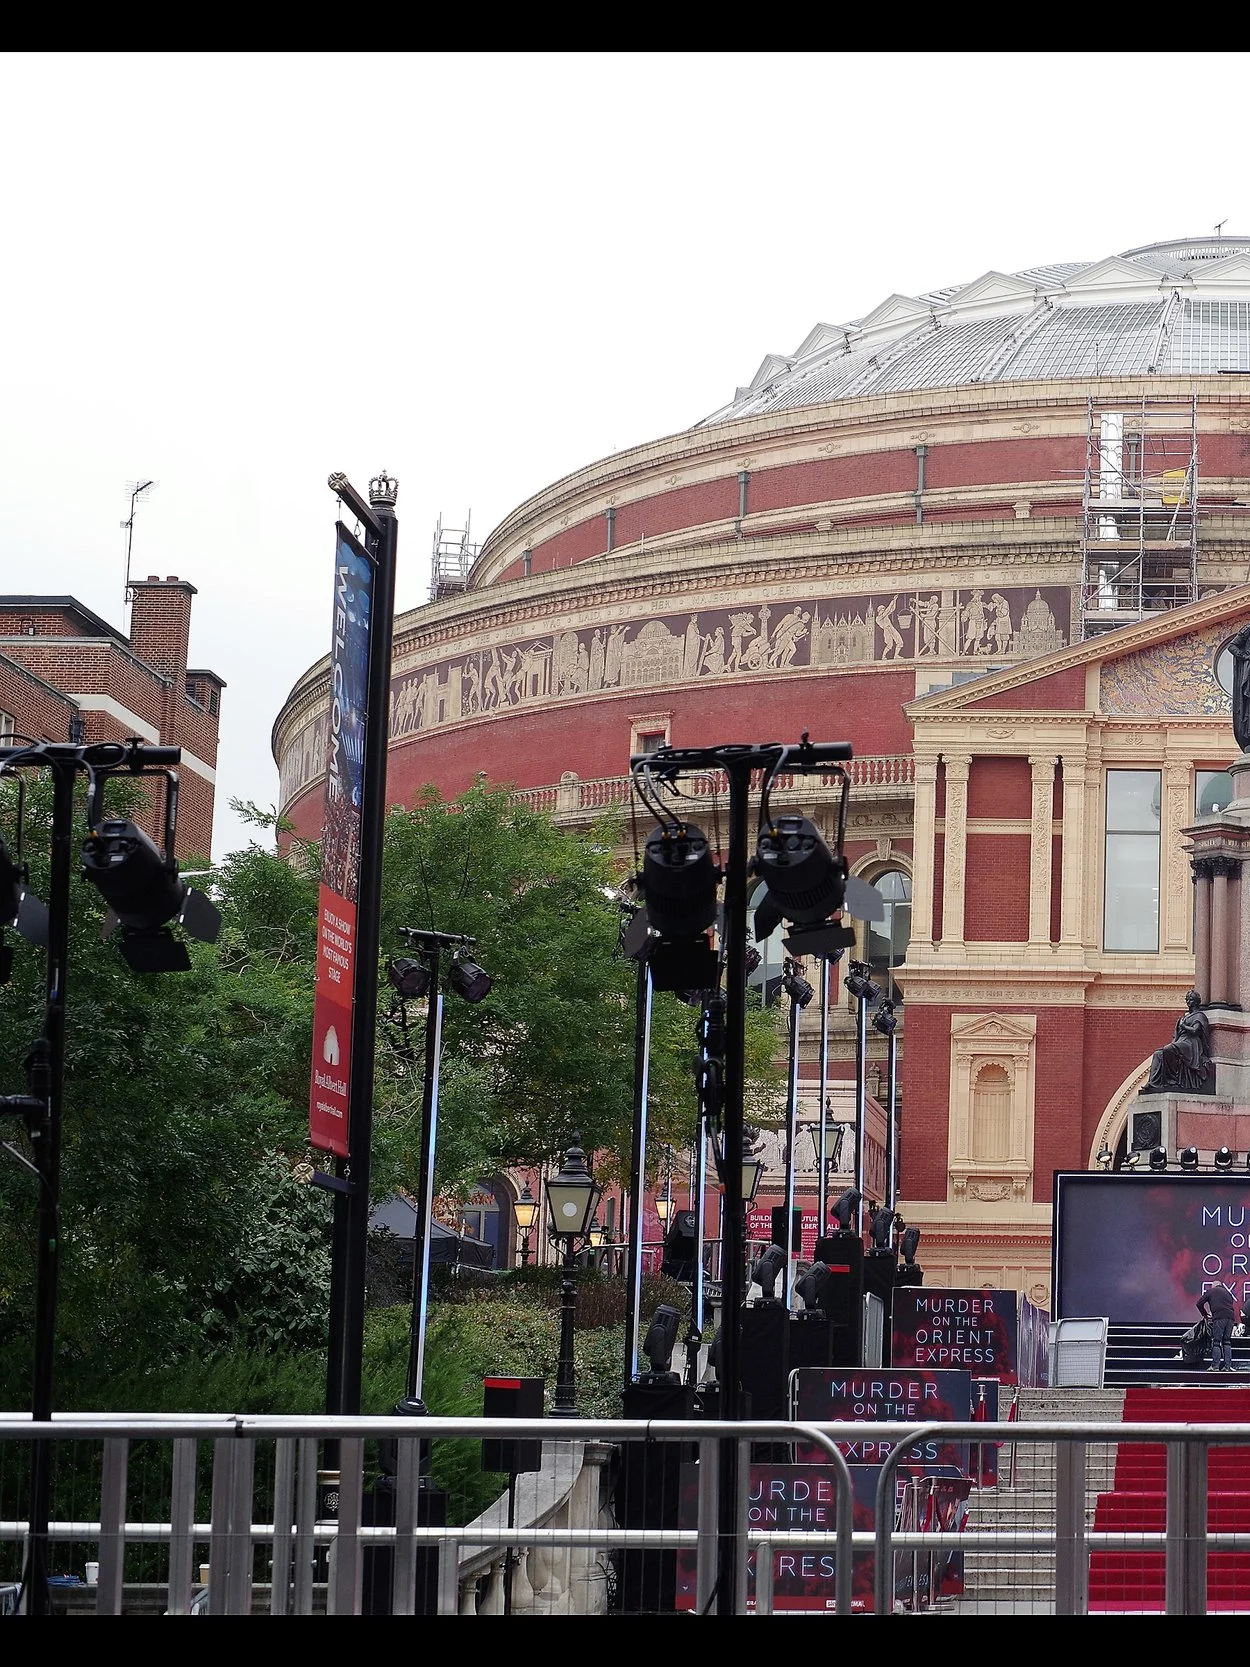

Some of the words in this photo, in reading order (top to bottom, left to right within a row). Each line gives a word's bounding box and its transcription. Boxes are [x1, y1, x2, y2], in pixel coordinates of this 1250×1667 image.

[475, 633, 491, 646] THE
[505, 626, 525, 638] HALL
[578, 611, 600, 623] LAID
[619, 606, 632, 615] BY
[651, 599, 671, 610] HER
[692, 590, 739, 606] MAJESTY
[762, 585, 800, 597] QUEEN
[824, 579, 881, 591] VICTORIA
[907, 575, 925, 585] ON
[951, 573, 974, 583] THE
[1000, 568, 1077, 580] TWENTIETH
[1204, 568, 1233, 578] MAY
[328, 566, 349, 803] WELCOME
[916, 1299, 994, 1313] MURDER
[932, 1316, 950, 1326] ON
[955, 1317, 978, 1327] THE
[916, 1329, 994, 1344] ORIENT
[915, 1348, 994, 1363] EXPRESS
[831, 1381, 938, 1399] MURDER
[853, 1403, 877, 1415] ON
[884, 1403, 916, 1416] THE
[749, 1507, 777, 1522] ON
[787, 1507, 826, 1522] THE
